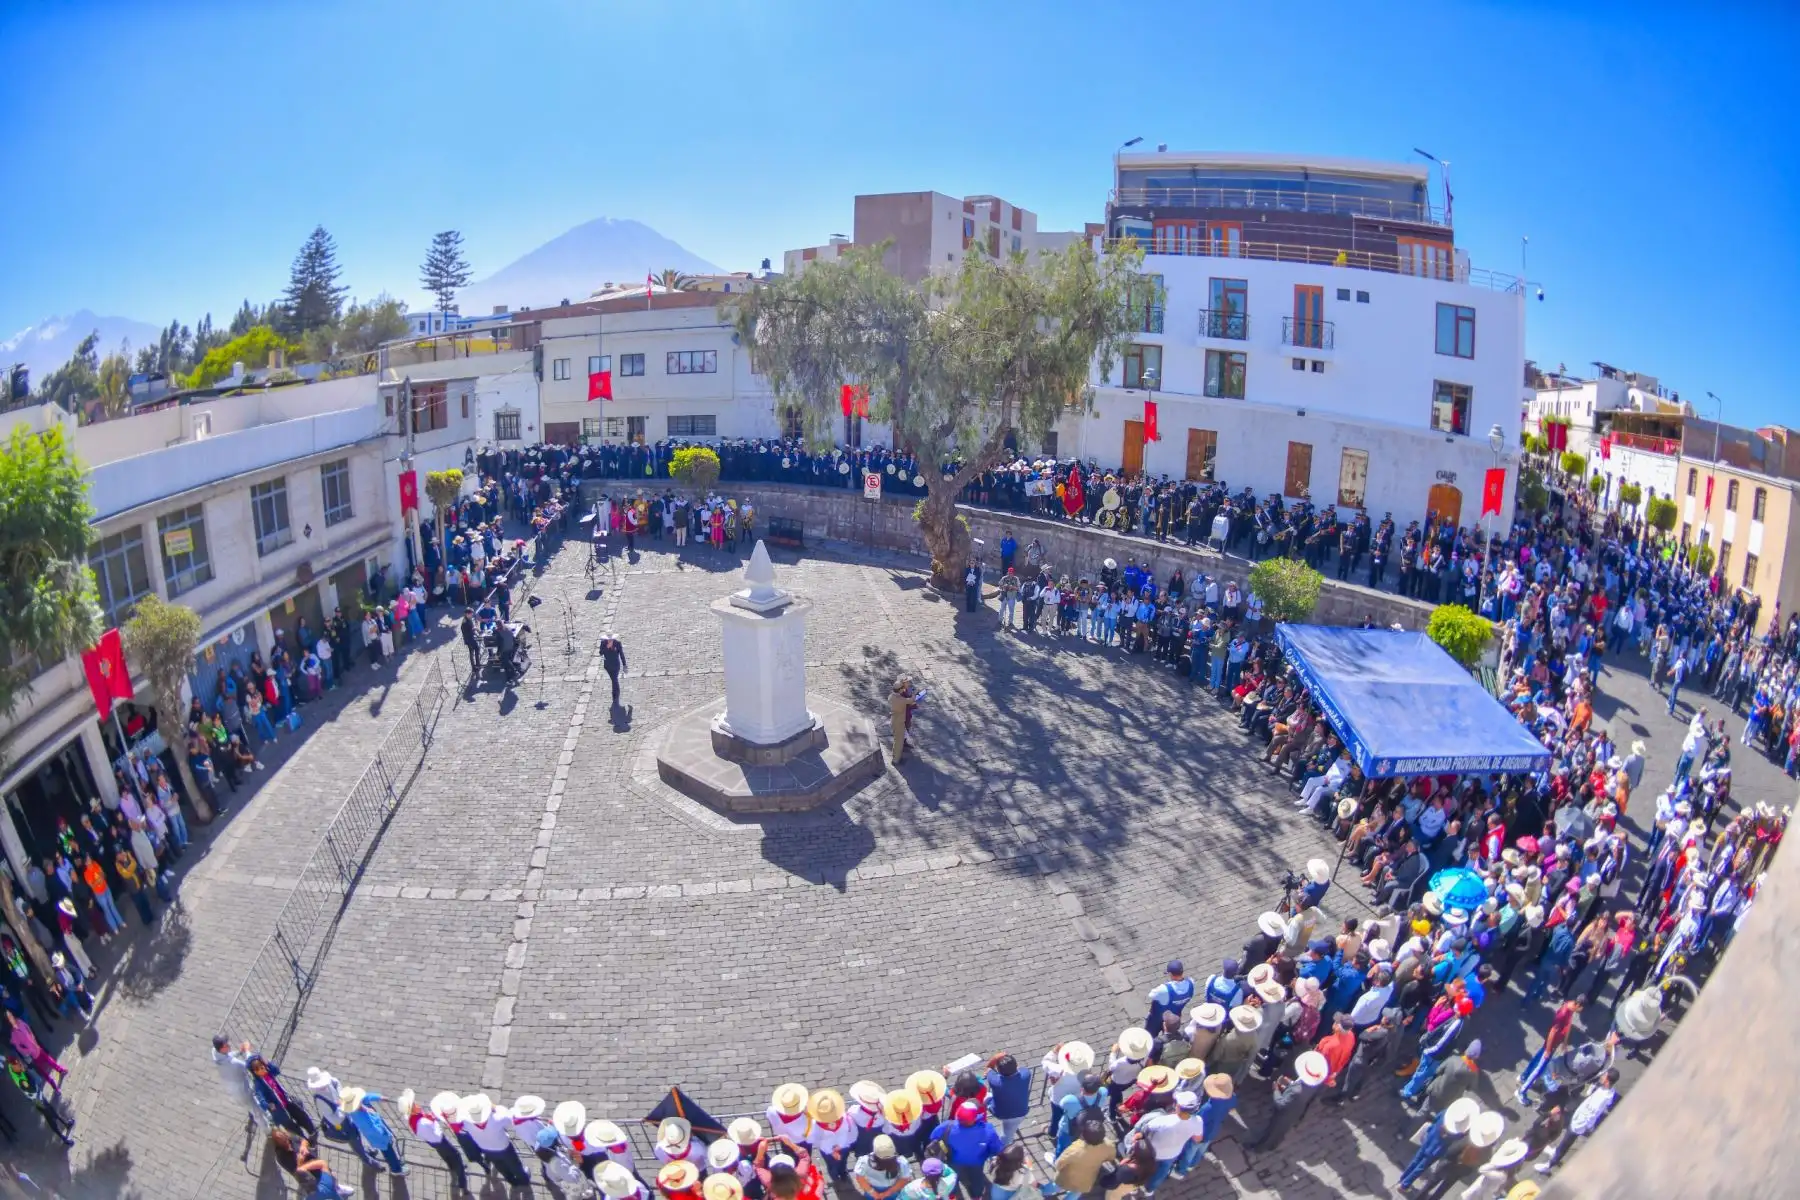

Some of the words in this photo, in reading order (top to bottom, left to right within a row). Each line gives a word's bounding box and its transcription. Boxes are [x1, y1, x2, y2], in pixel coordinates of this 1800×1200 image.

[1394, 758, 1453, 773] MUNICIPALIDAD
[1451, 756, 1491, 770] PROVINCIAL
[1491, 756, 1503, 769] DE
[1500, 756, 1532, 769] AREQUIPA
